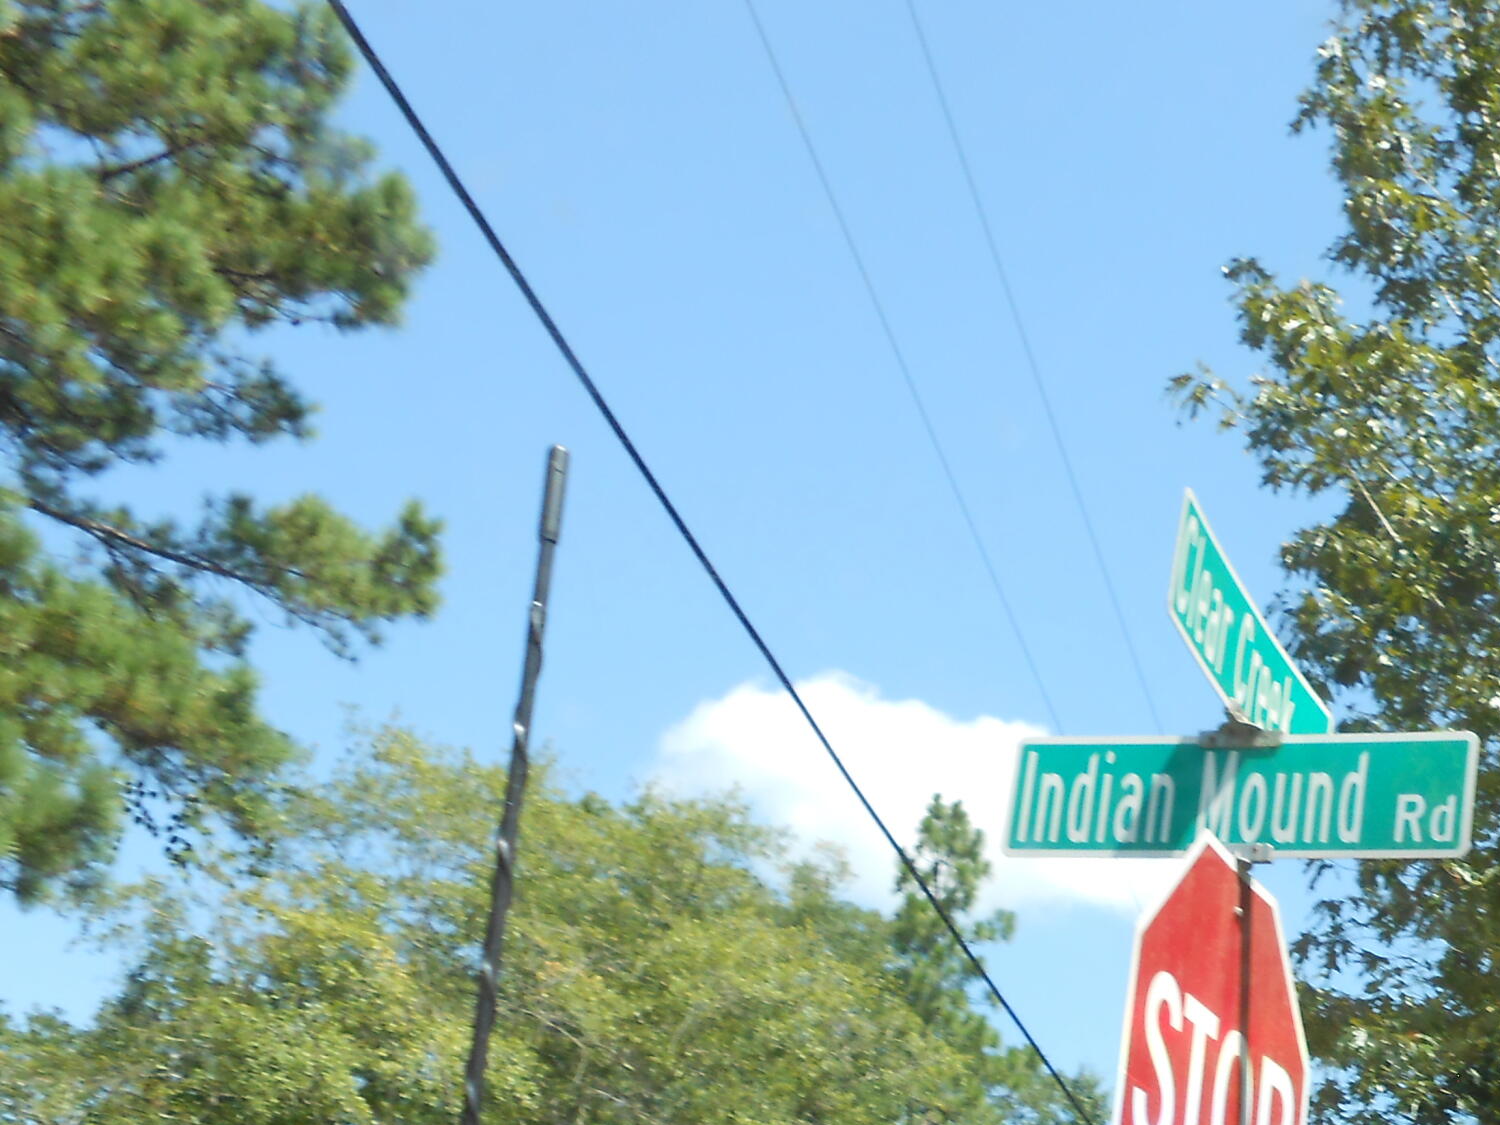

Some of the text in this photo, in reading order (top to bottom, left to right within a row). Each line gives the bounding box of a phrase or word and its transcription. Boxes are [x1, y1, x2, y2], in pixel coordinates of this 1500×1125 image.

[1176, 515, 1295, 734] Clear Creek
[1017, 750, 1457, 843] Indian Mound Rd
